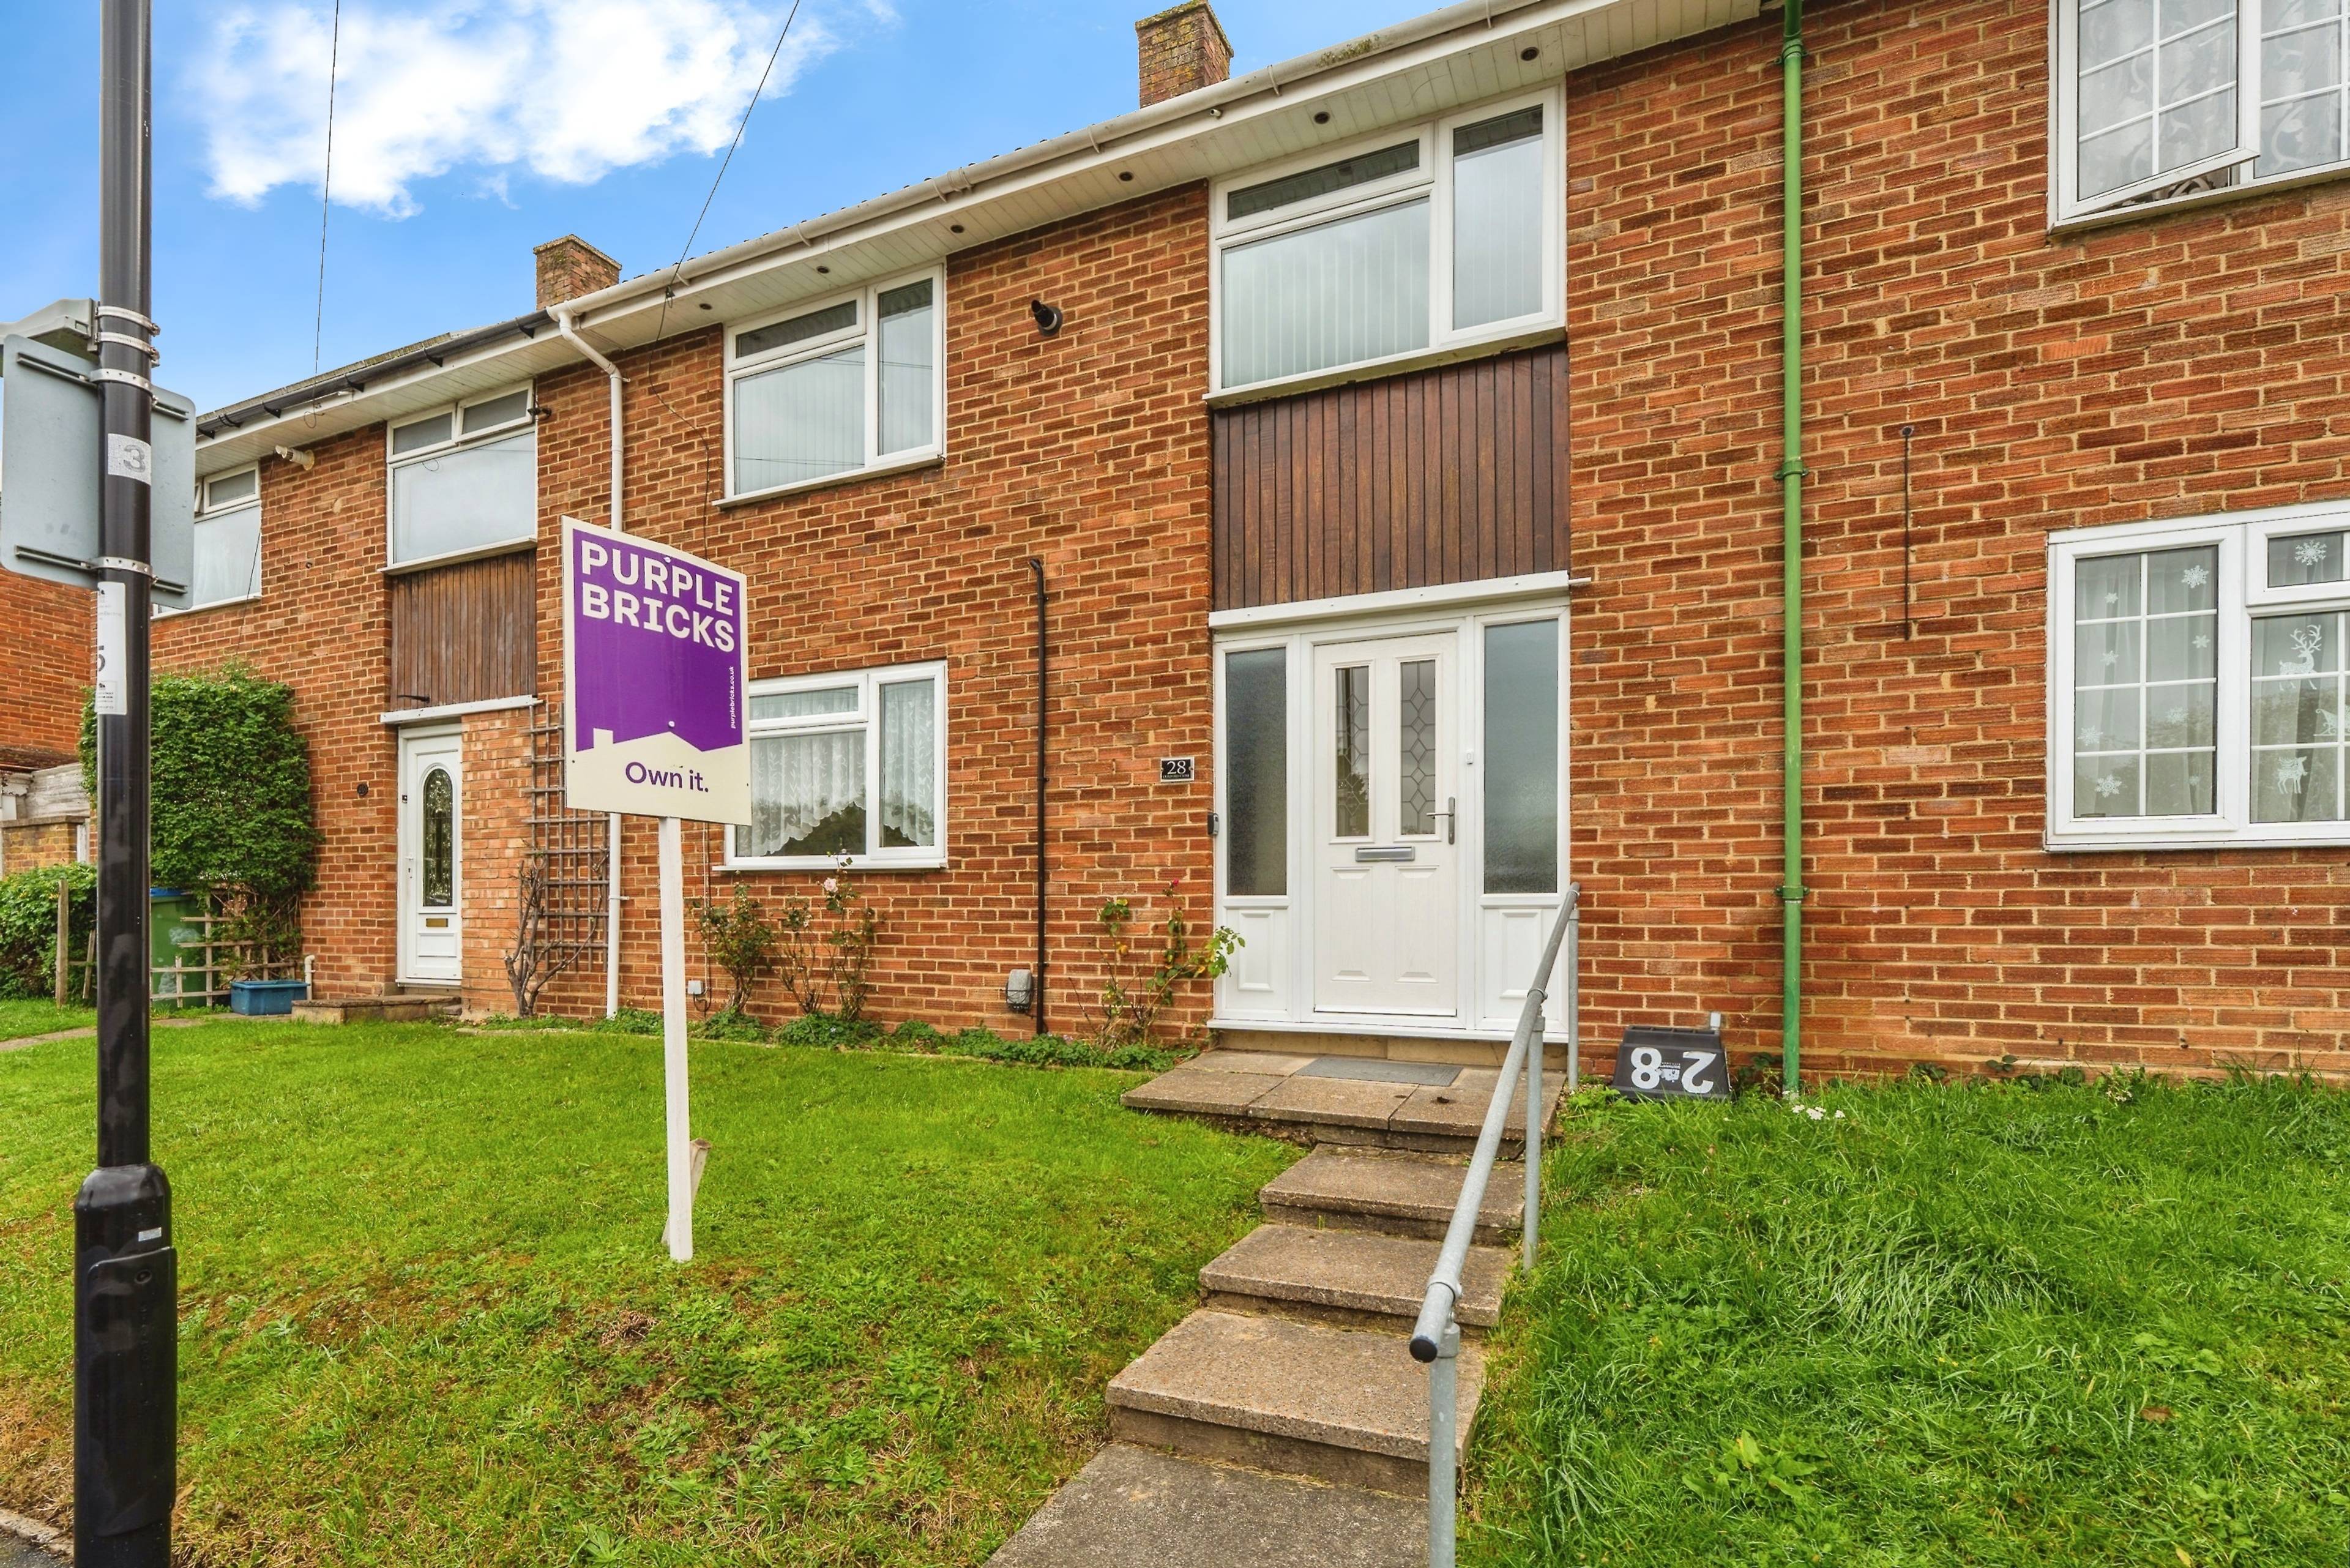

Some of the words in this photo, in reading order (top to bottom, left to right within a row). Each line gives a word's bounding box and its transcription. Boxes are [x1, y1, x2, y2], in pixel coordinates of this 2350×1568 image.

[124, 444, 146, 473] 3
[581, 540, 733, 616] PURPLE
[582, 582, 734, 652] BRICKS
[625, 762, 682, 789] Own
[689, 769, 709, 793] it.
[1167, 760, 1186, 774] 28
